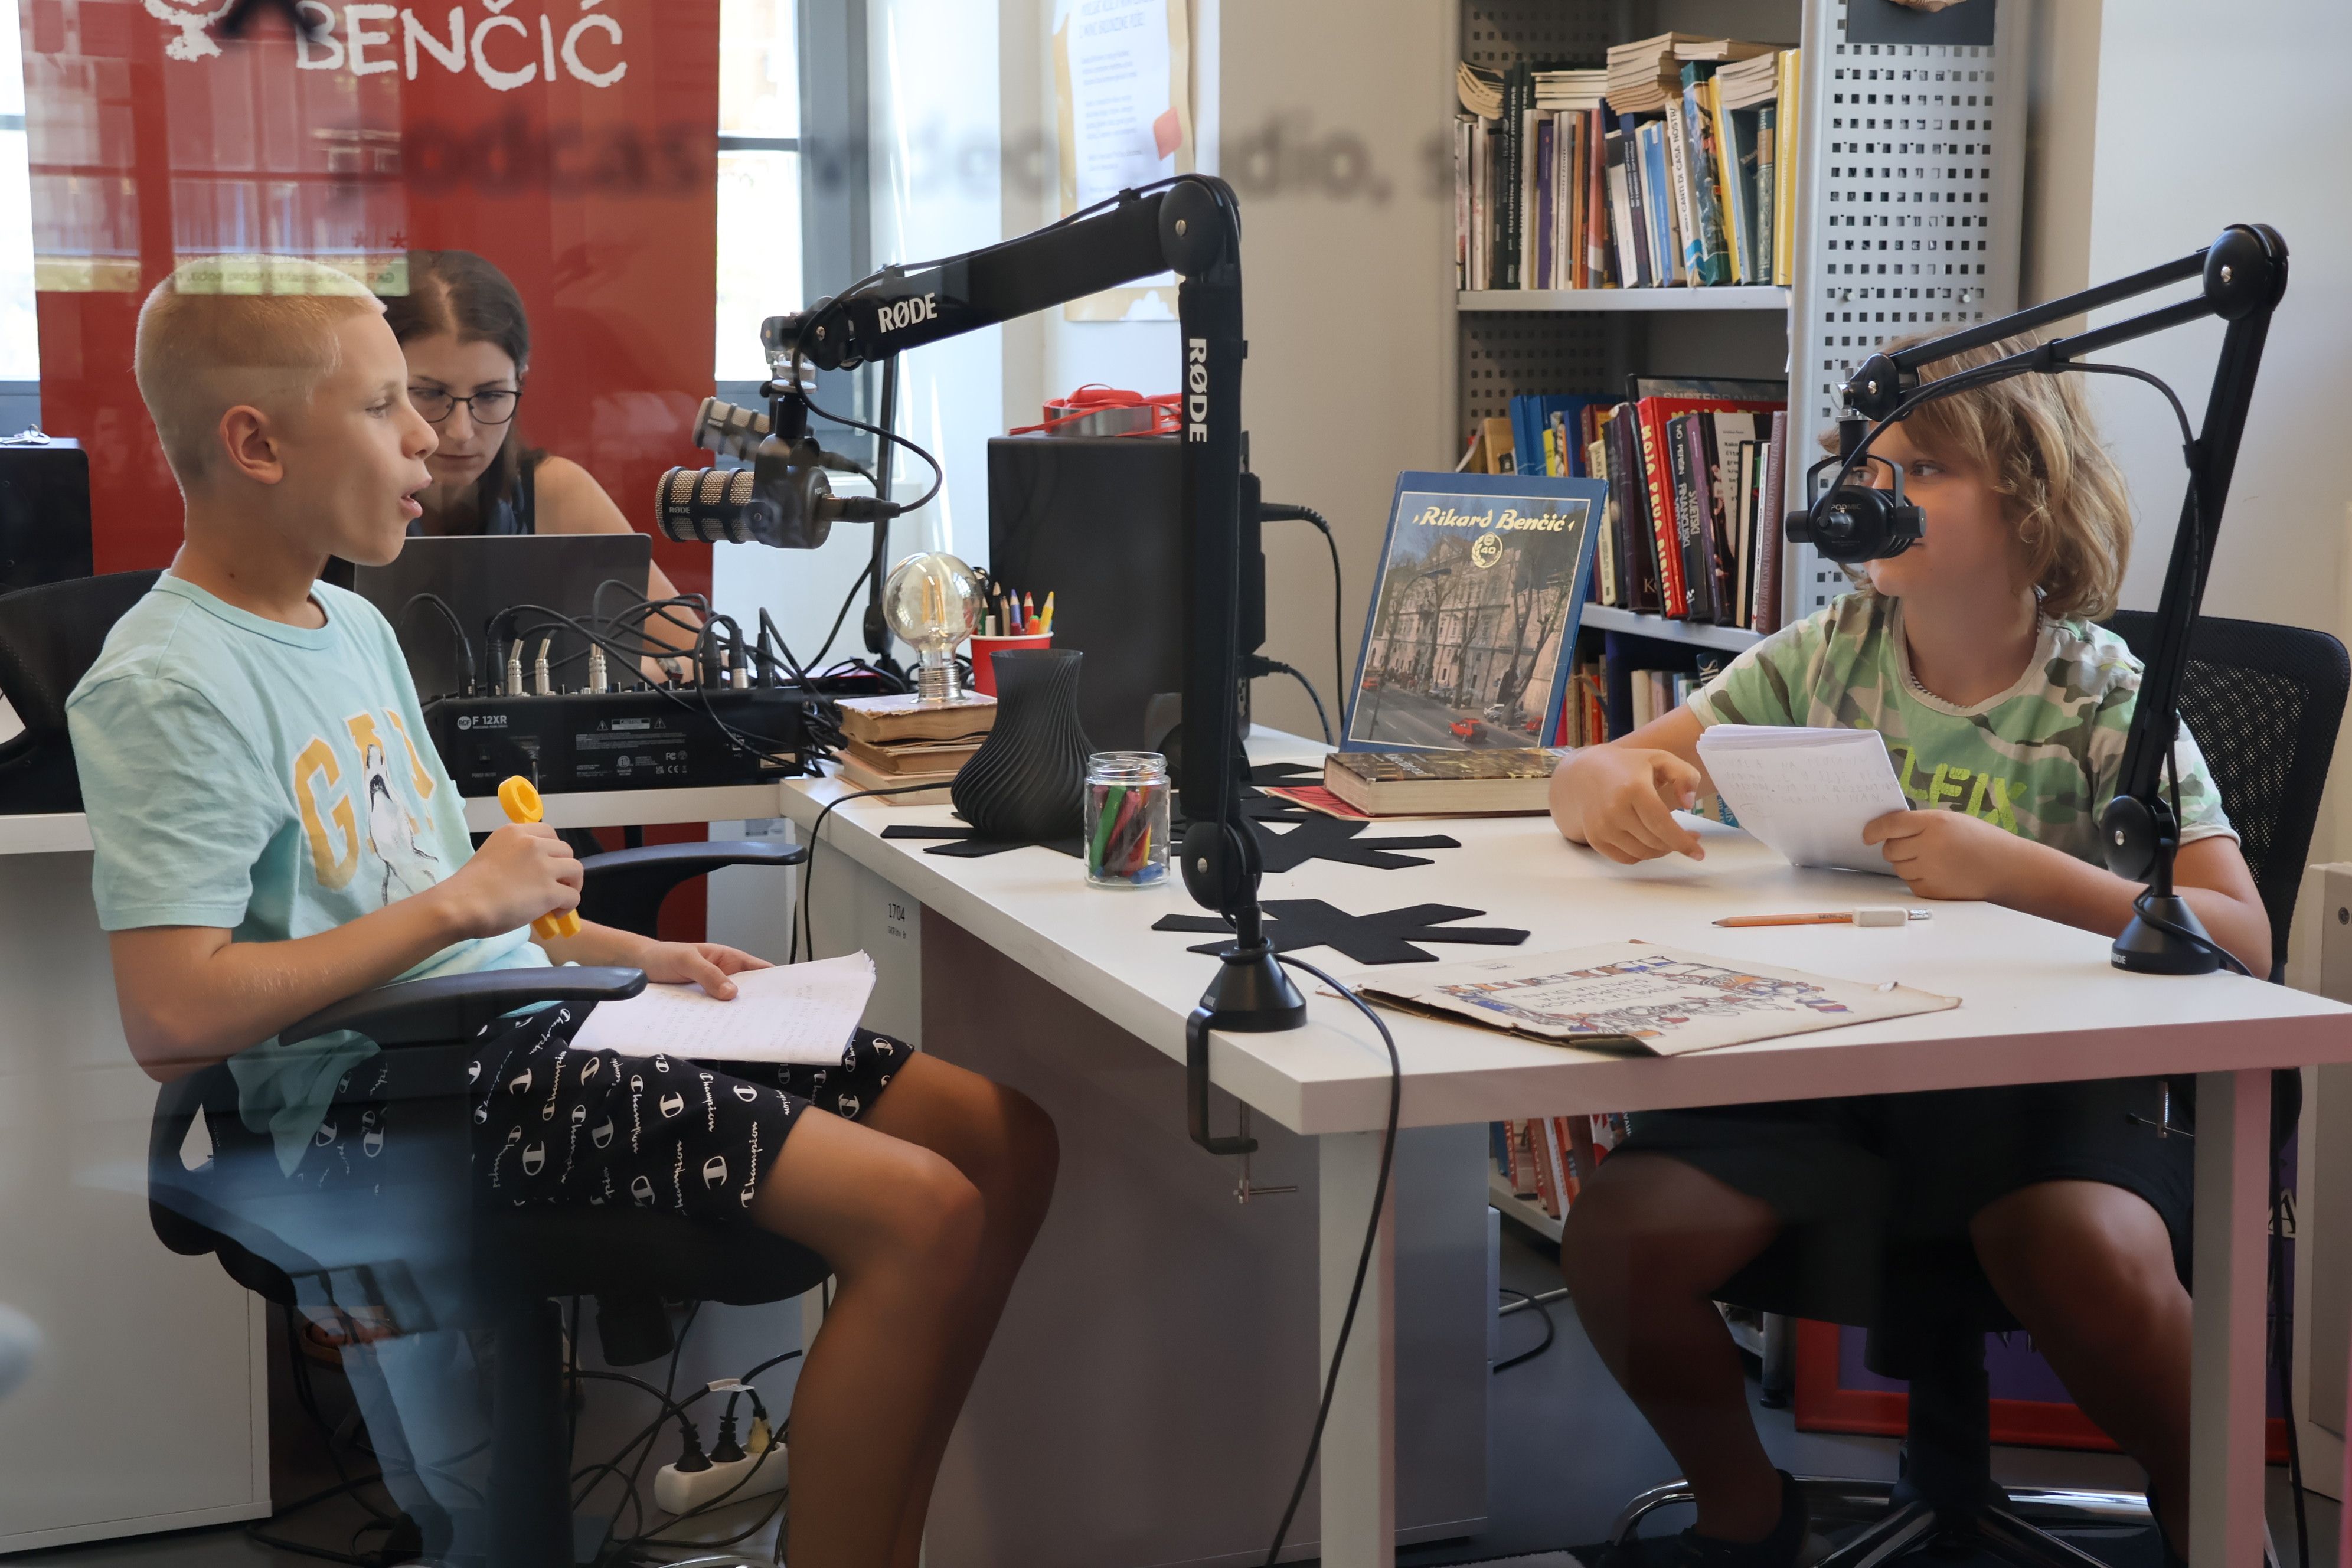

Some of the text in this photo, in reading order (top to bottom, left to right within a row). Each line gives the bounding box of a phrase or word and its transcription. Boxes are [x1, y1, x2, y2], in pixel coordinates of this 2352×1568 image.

[1674, 146, 1683, 171] CASA
[1677, 174, 1684, 183] DI
[1678, 187, 1688, 213] CANTI
[878, 292, 937, 334] RØDE
[1189, 338, 1208, 442] RØDE
[1641, 425, 1656, 475] MOJA
[1495, 509, 1567, 531] Benčić
[1688, 491, 1700, 535] SVJETSKI
[472, 716, 479, 725] F
[483, 715, 507, 725] 12XR
[888, 903, 906, 922] 1704
[700, 1072, 717, 1132] Champion
[741, 1121, 763, 1208] Champion
